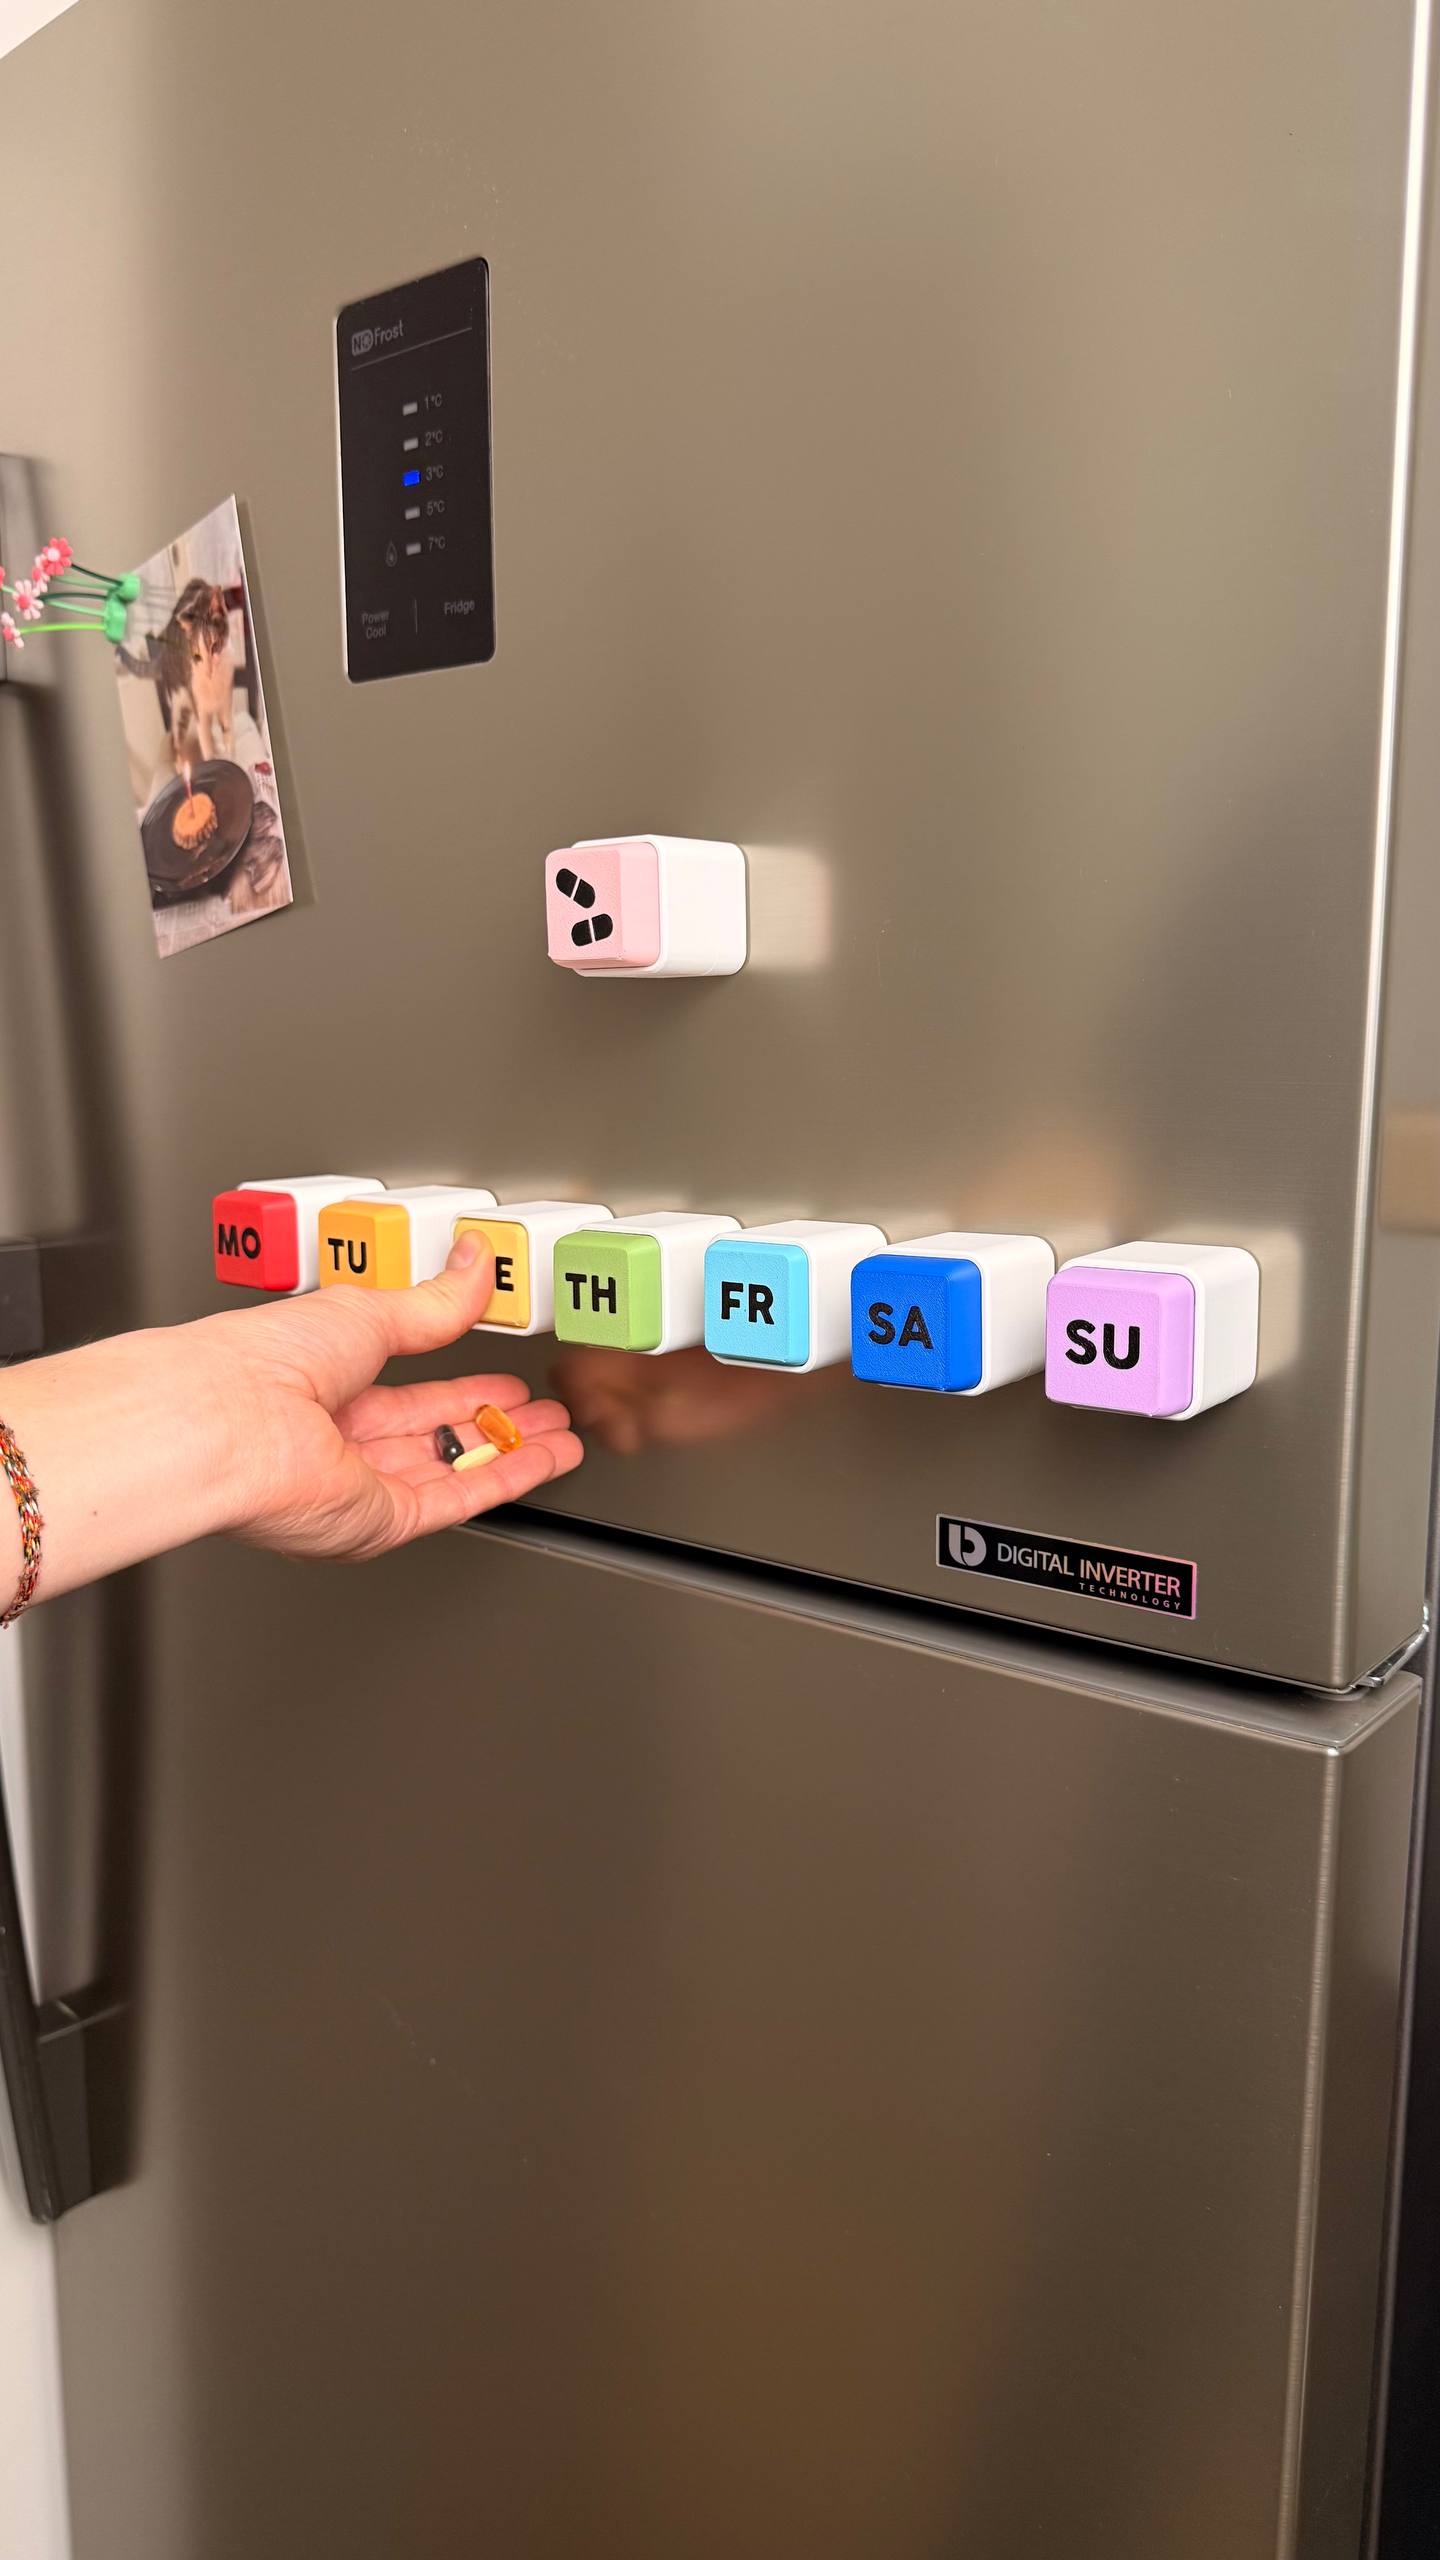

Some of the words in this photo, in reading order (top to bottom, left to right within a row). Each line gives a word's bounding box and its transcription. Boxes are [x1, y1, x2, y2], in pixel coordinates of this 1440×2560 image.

[425, 430, 443, 447] 2°C
[426, 465, 444, 481] 3°C
[428, 536, 446, 552] 7°C
[362, 610, 389, 625] Power
[444, 600, 475, 615] Fridge
[366, 624, 387, 639] Cool
[218, 1223, 261, 1260] MO
[328, 1238, 367, 1274] TU
[495, 1256, 515, 1292] E
[565, 1272, 617, 1314] TH
[720, 1282, 775, 1325] FR
[868, 1302, 934, 1350] SA
[1065, 1319, 1141, 1370] SU
[997, 1542, 1075, 1577] DIGITAL
[1080, 1559, 1181, 1598] INVERTER
[1079, 1582, 1181, 1610] TECHNOLOGY
